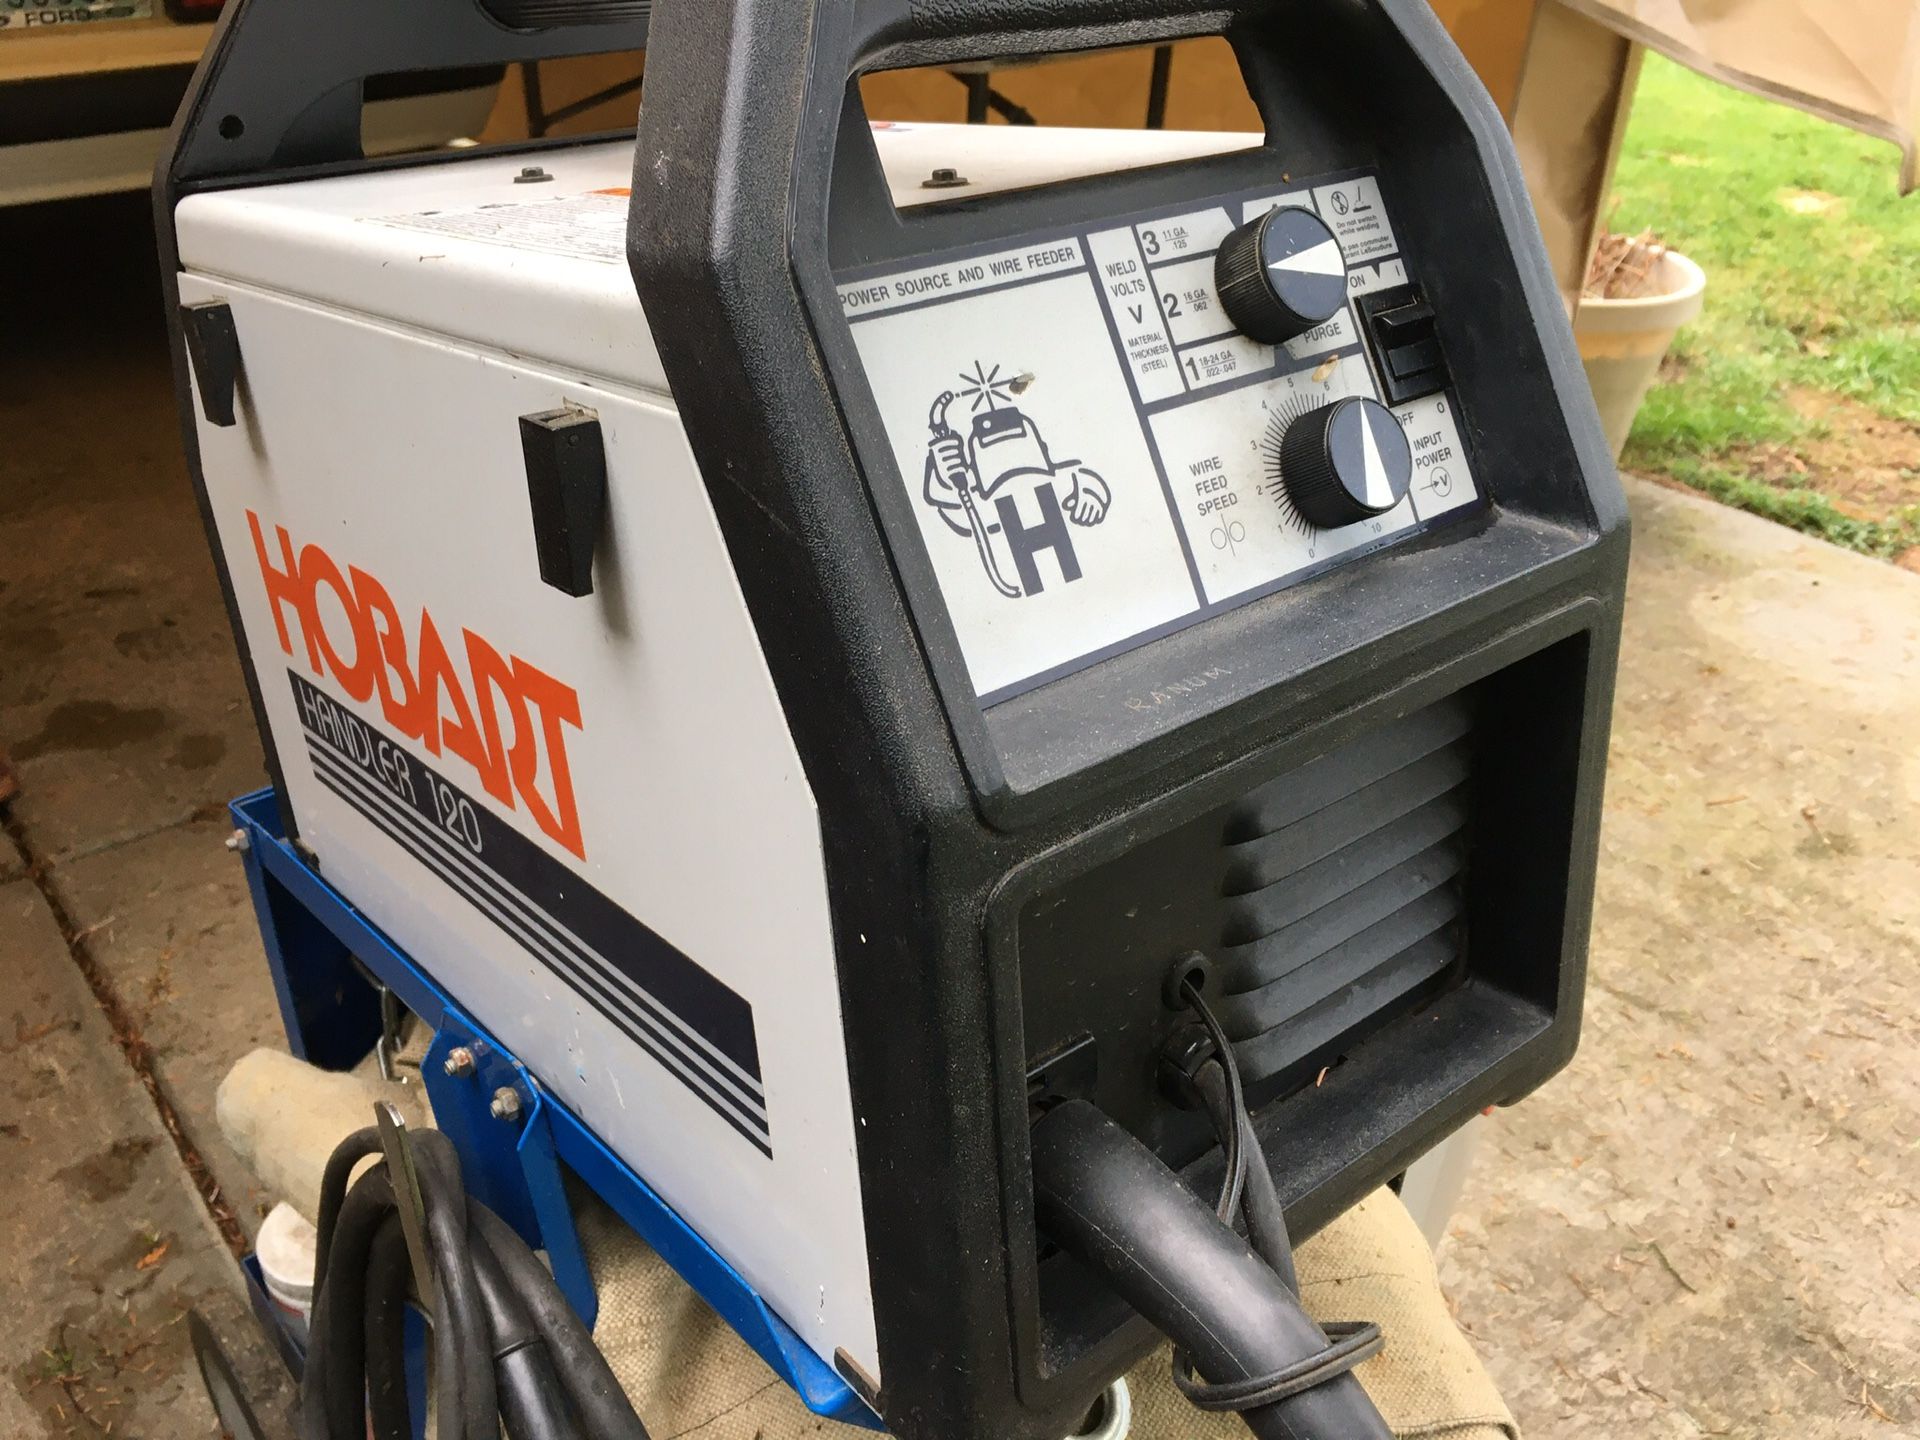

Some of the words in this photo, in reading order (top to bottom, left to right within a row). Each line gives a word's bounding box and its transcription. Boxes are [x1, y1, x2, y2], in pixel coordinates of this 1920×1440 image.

[1357, 214, 1377, 224] switch
[1162, 229, 1172, 239] 11
[1339, 228, 1355, 236] while
[1356, 222, 1380, 232] welding
[1142, 230, 1160, 255] 3
[1172, 239, 1188, 250] .125
[1348, 243, 1359, 251] pas
[1360, 235, 1389, 247] commuter
[1105, 259, 1137, 277] WELD
[838, 285, 890, 308] POWER
[895, 272, 952, 297] SOURCE
[957, 265, 985, 284] AND
[989, 257, 1023, 277] WIRE
[1027, 247, 1076, 269] FEEDER
[1349, 274, 1366, 288] ON
[1110, 279, 1146, 297] VOLTS
[1183, 291, 1193, 301] 16
[1128, 304, 1142, 324] V
[1163, 293, 1182, 319] 2
[1128, 332, 1163, 348] MATERIAL
[1303, 322, 1342, 343] PURGE
[1130, 343, 1169, 361] THICKNESS
[1199, 352, 1219, 367] 18-24
[1141, 359, 1168, 374] (STEEL)
[1185, 357, 1200, 381] 1
[1287, 377, 1294, 388] 5
[1324, 381, 1330, 391] 6
[1261, 400, 1268, 410] 4
[1250, 440, 1257, 450] 3
[1413, 432, 1442, 451] INPUT
[1189, 456, 1223, 477] WIRE
[1415, 447, 1452, 470] POWER
[1195, 474, 1228, 496] FEED
[1256, 485, 1264, 496] 2
[1197, 492, 1238, 517] SPEED
[1371, 522, 1382, 534] 10
[994, 482, 1083, 597] H
[245, 508, 587, 863] HOBART
[298, 676, 417, 806] HANDLER
[424, 770, 484, 854] 120
